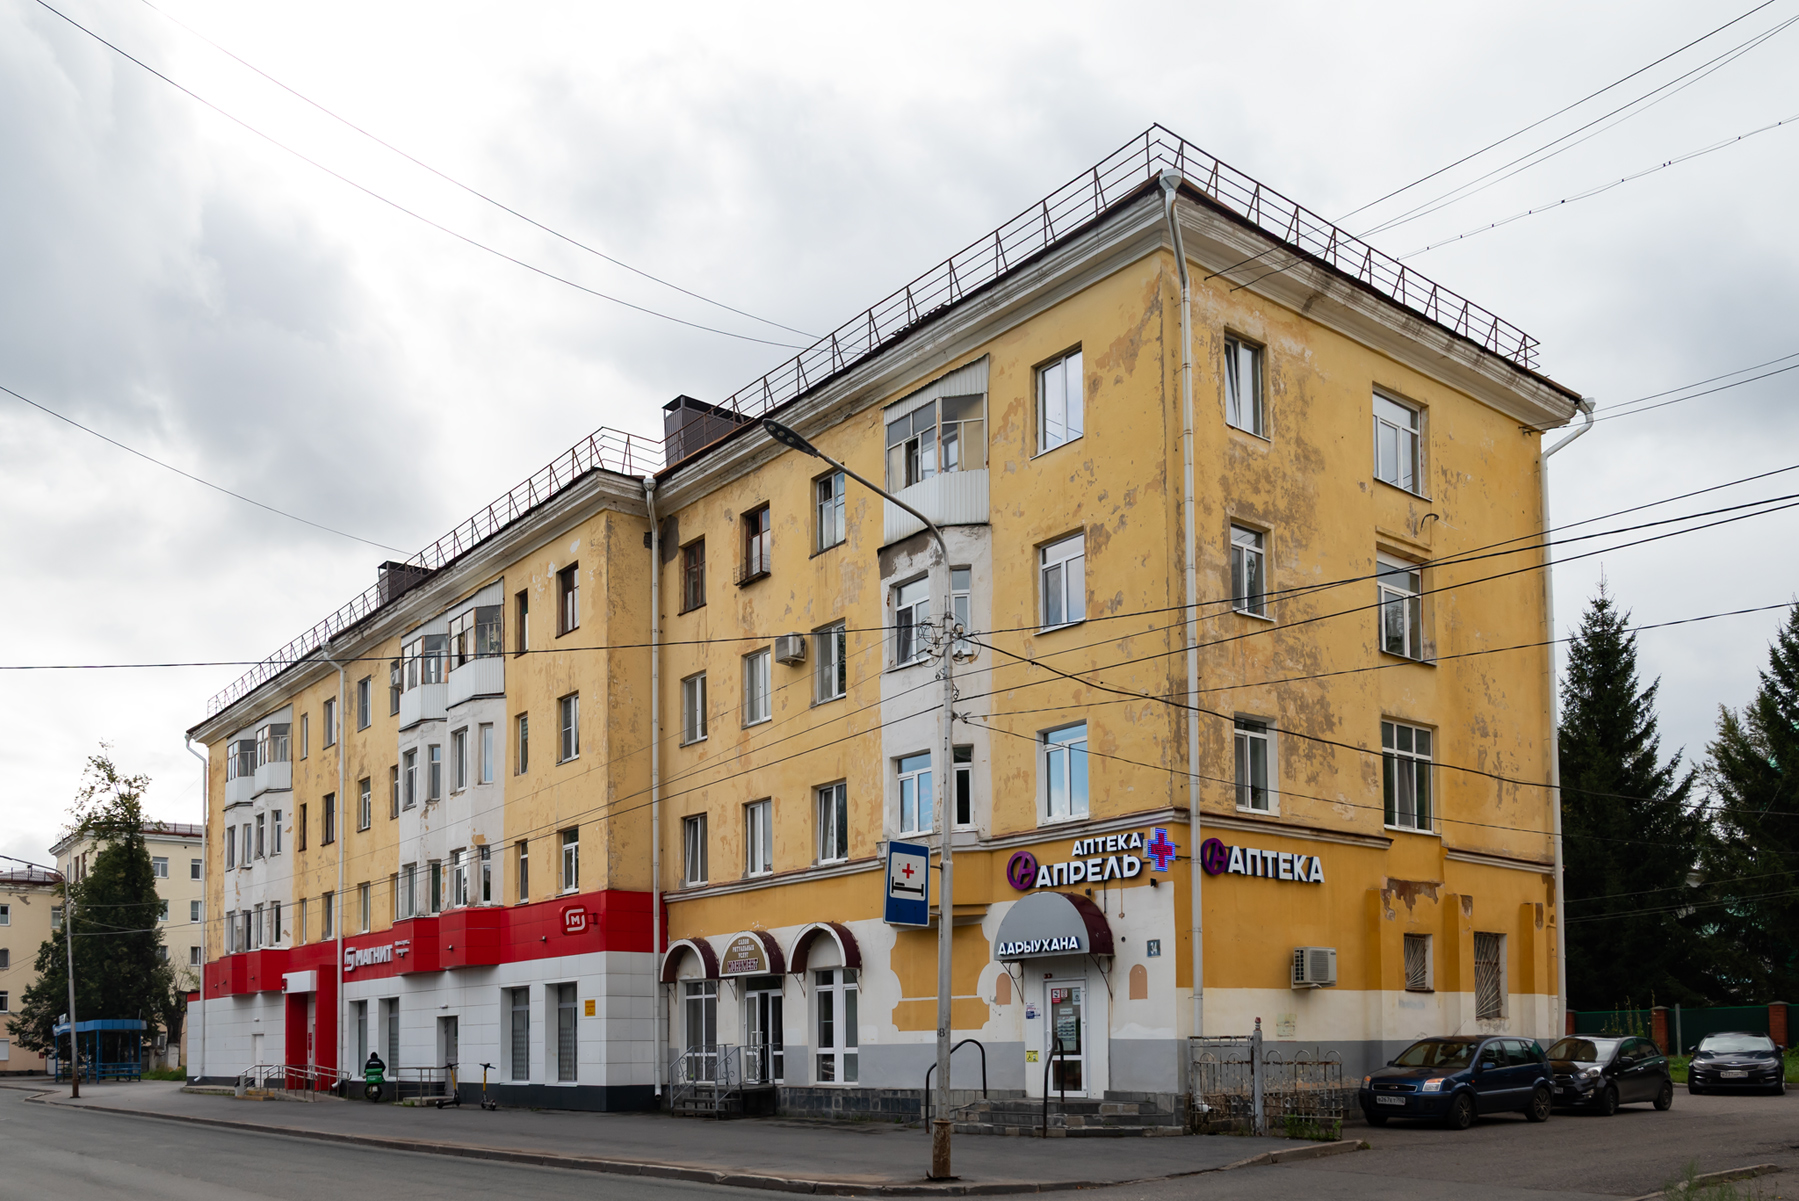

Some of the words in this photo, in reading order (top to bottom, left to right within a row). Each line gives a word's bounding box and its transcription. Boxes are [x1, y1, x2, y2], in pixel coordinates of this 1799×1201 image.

[1071, 832, 1142, 856] АПТЕКА
[1035, 854, 1142, 888] АПРЕЛЬ
[1228, 845, 1326, 883] АПТЕКА
[355, 944, 393, 967] МАГНИТ
